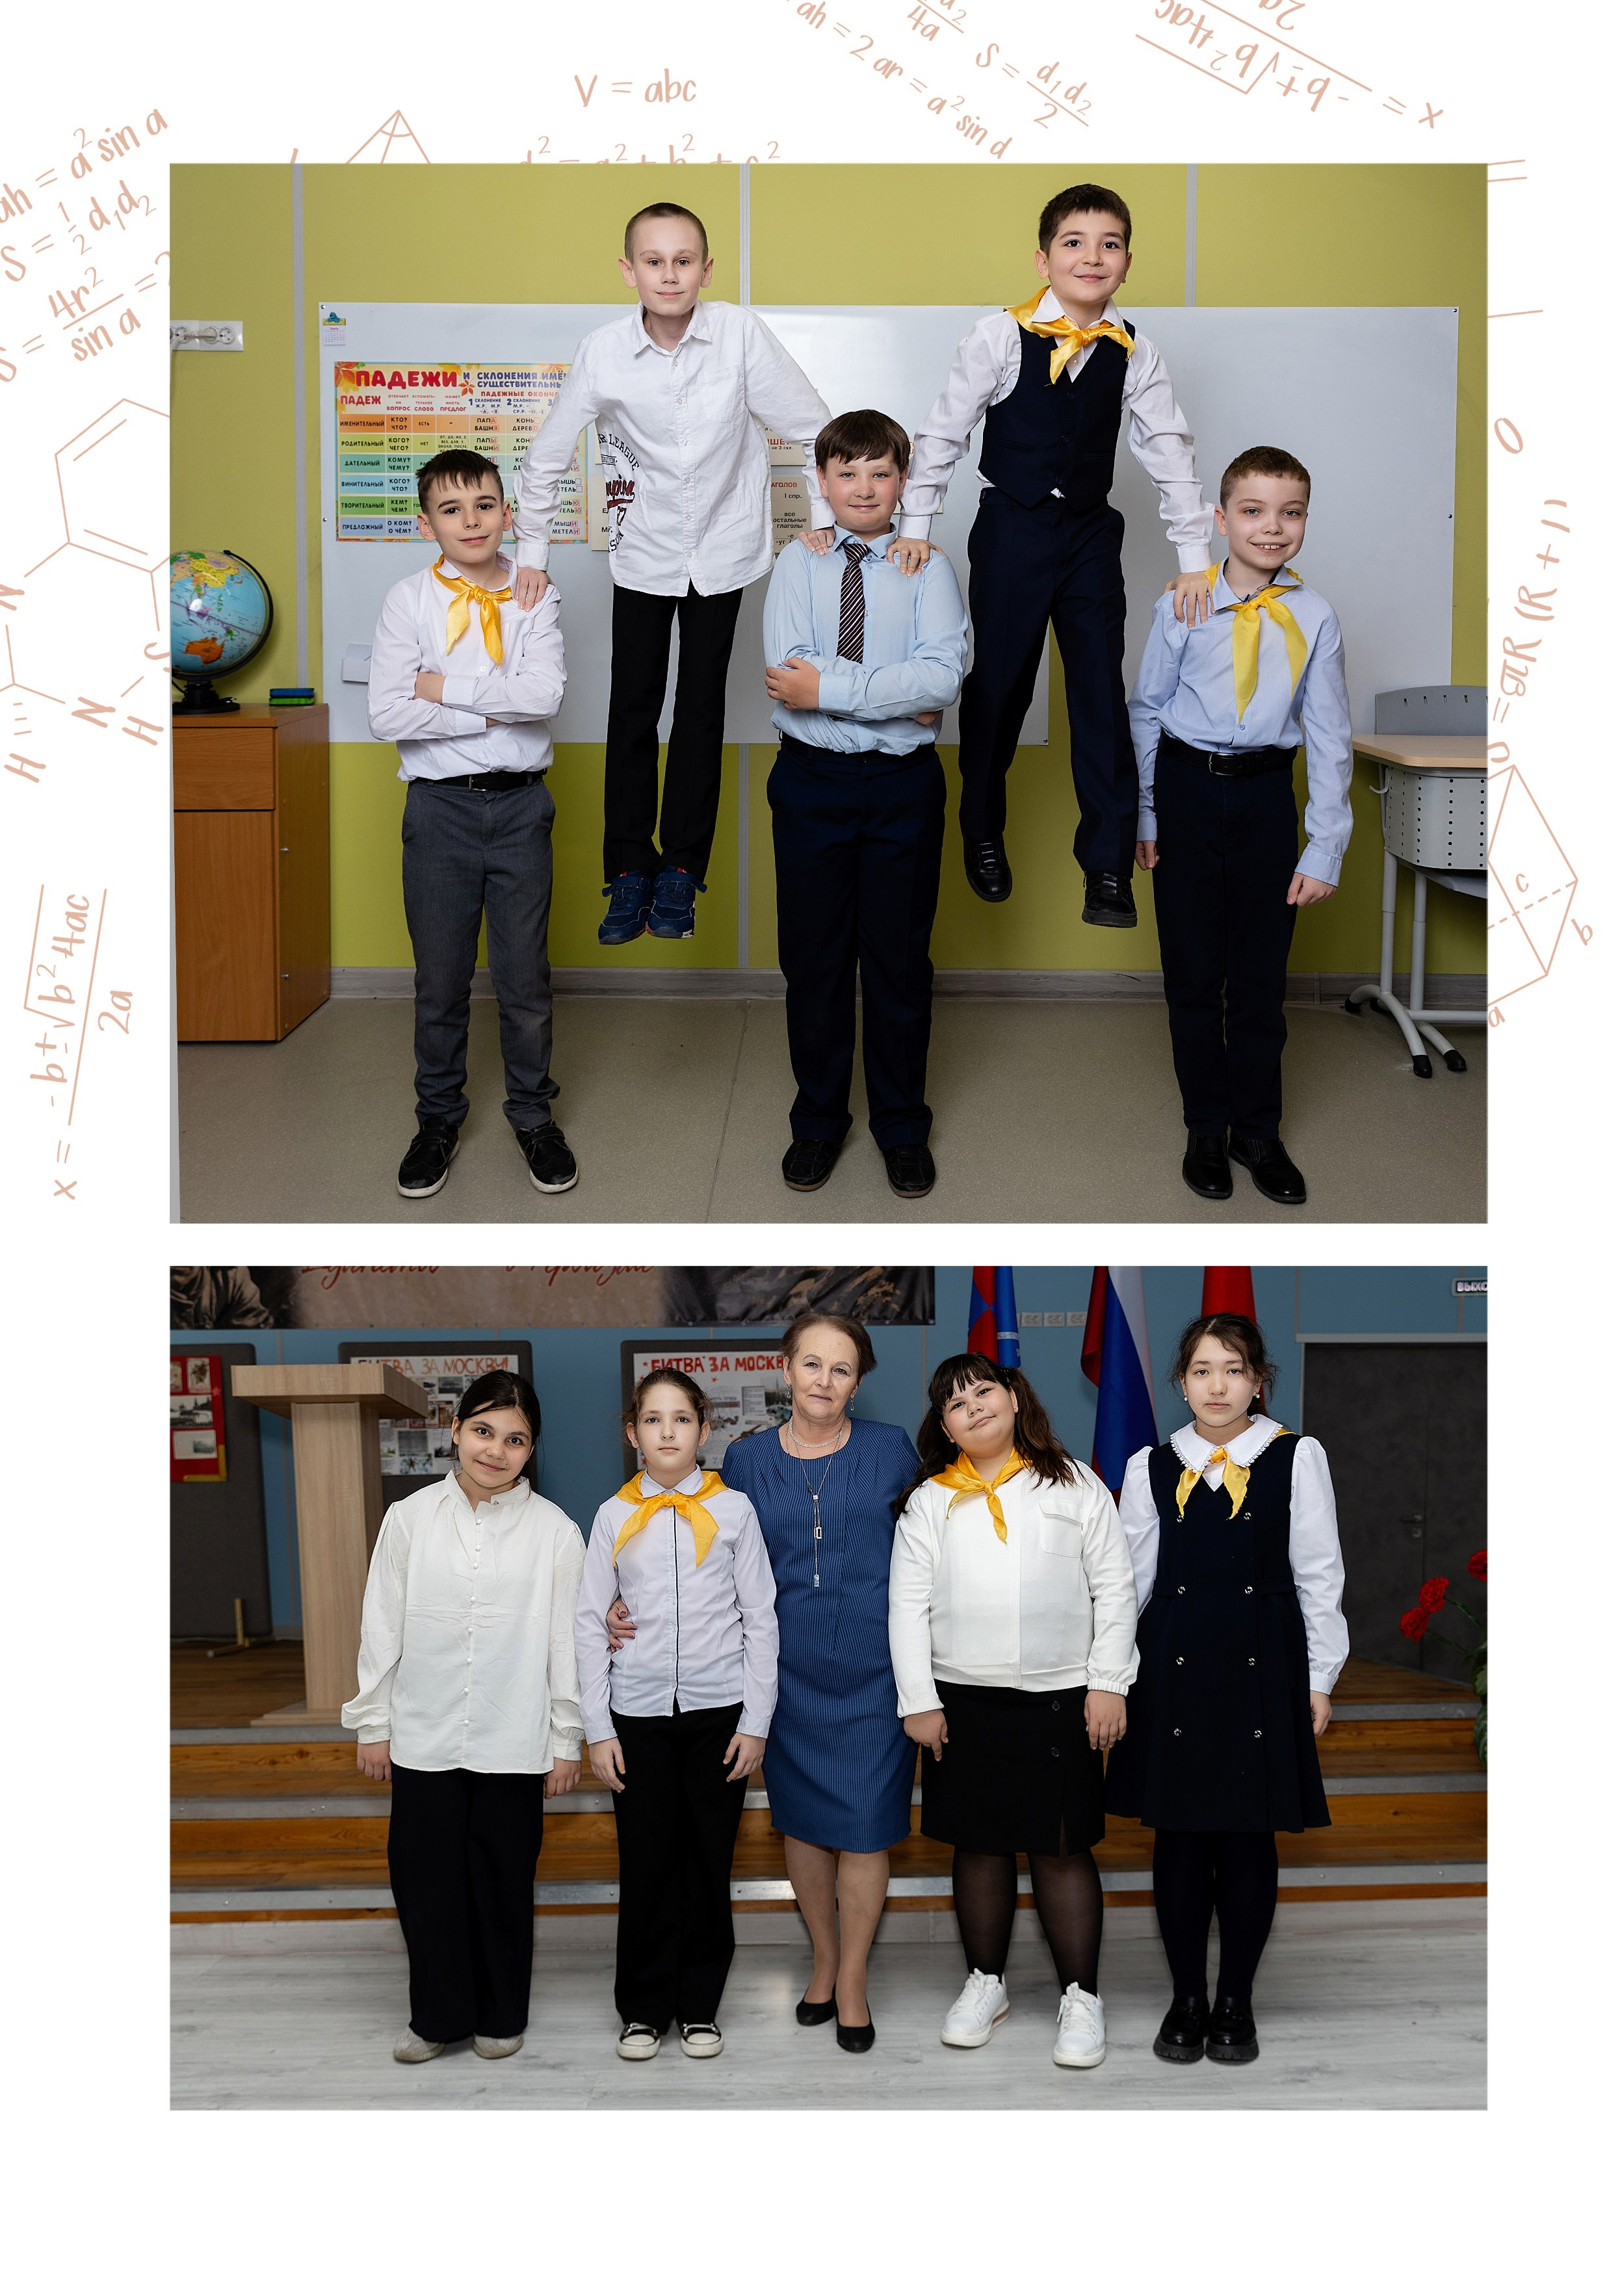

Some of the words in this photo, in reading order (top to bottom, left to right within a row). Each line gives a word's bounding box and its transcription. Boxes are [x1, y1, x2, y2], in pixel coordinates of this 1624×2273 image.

[356, 370, 457, 389] ПАДЕЖИ
[340, 395, 381, 406] ПАДЕЖ
[609, 434, 640, 471] LEAGUE
[651, 1357, 704, 1373] БИТВА
[709, 1356, 729, 1372] ЗА
